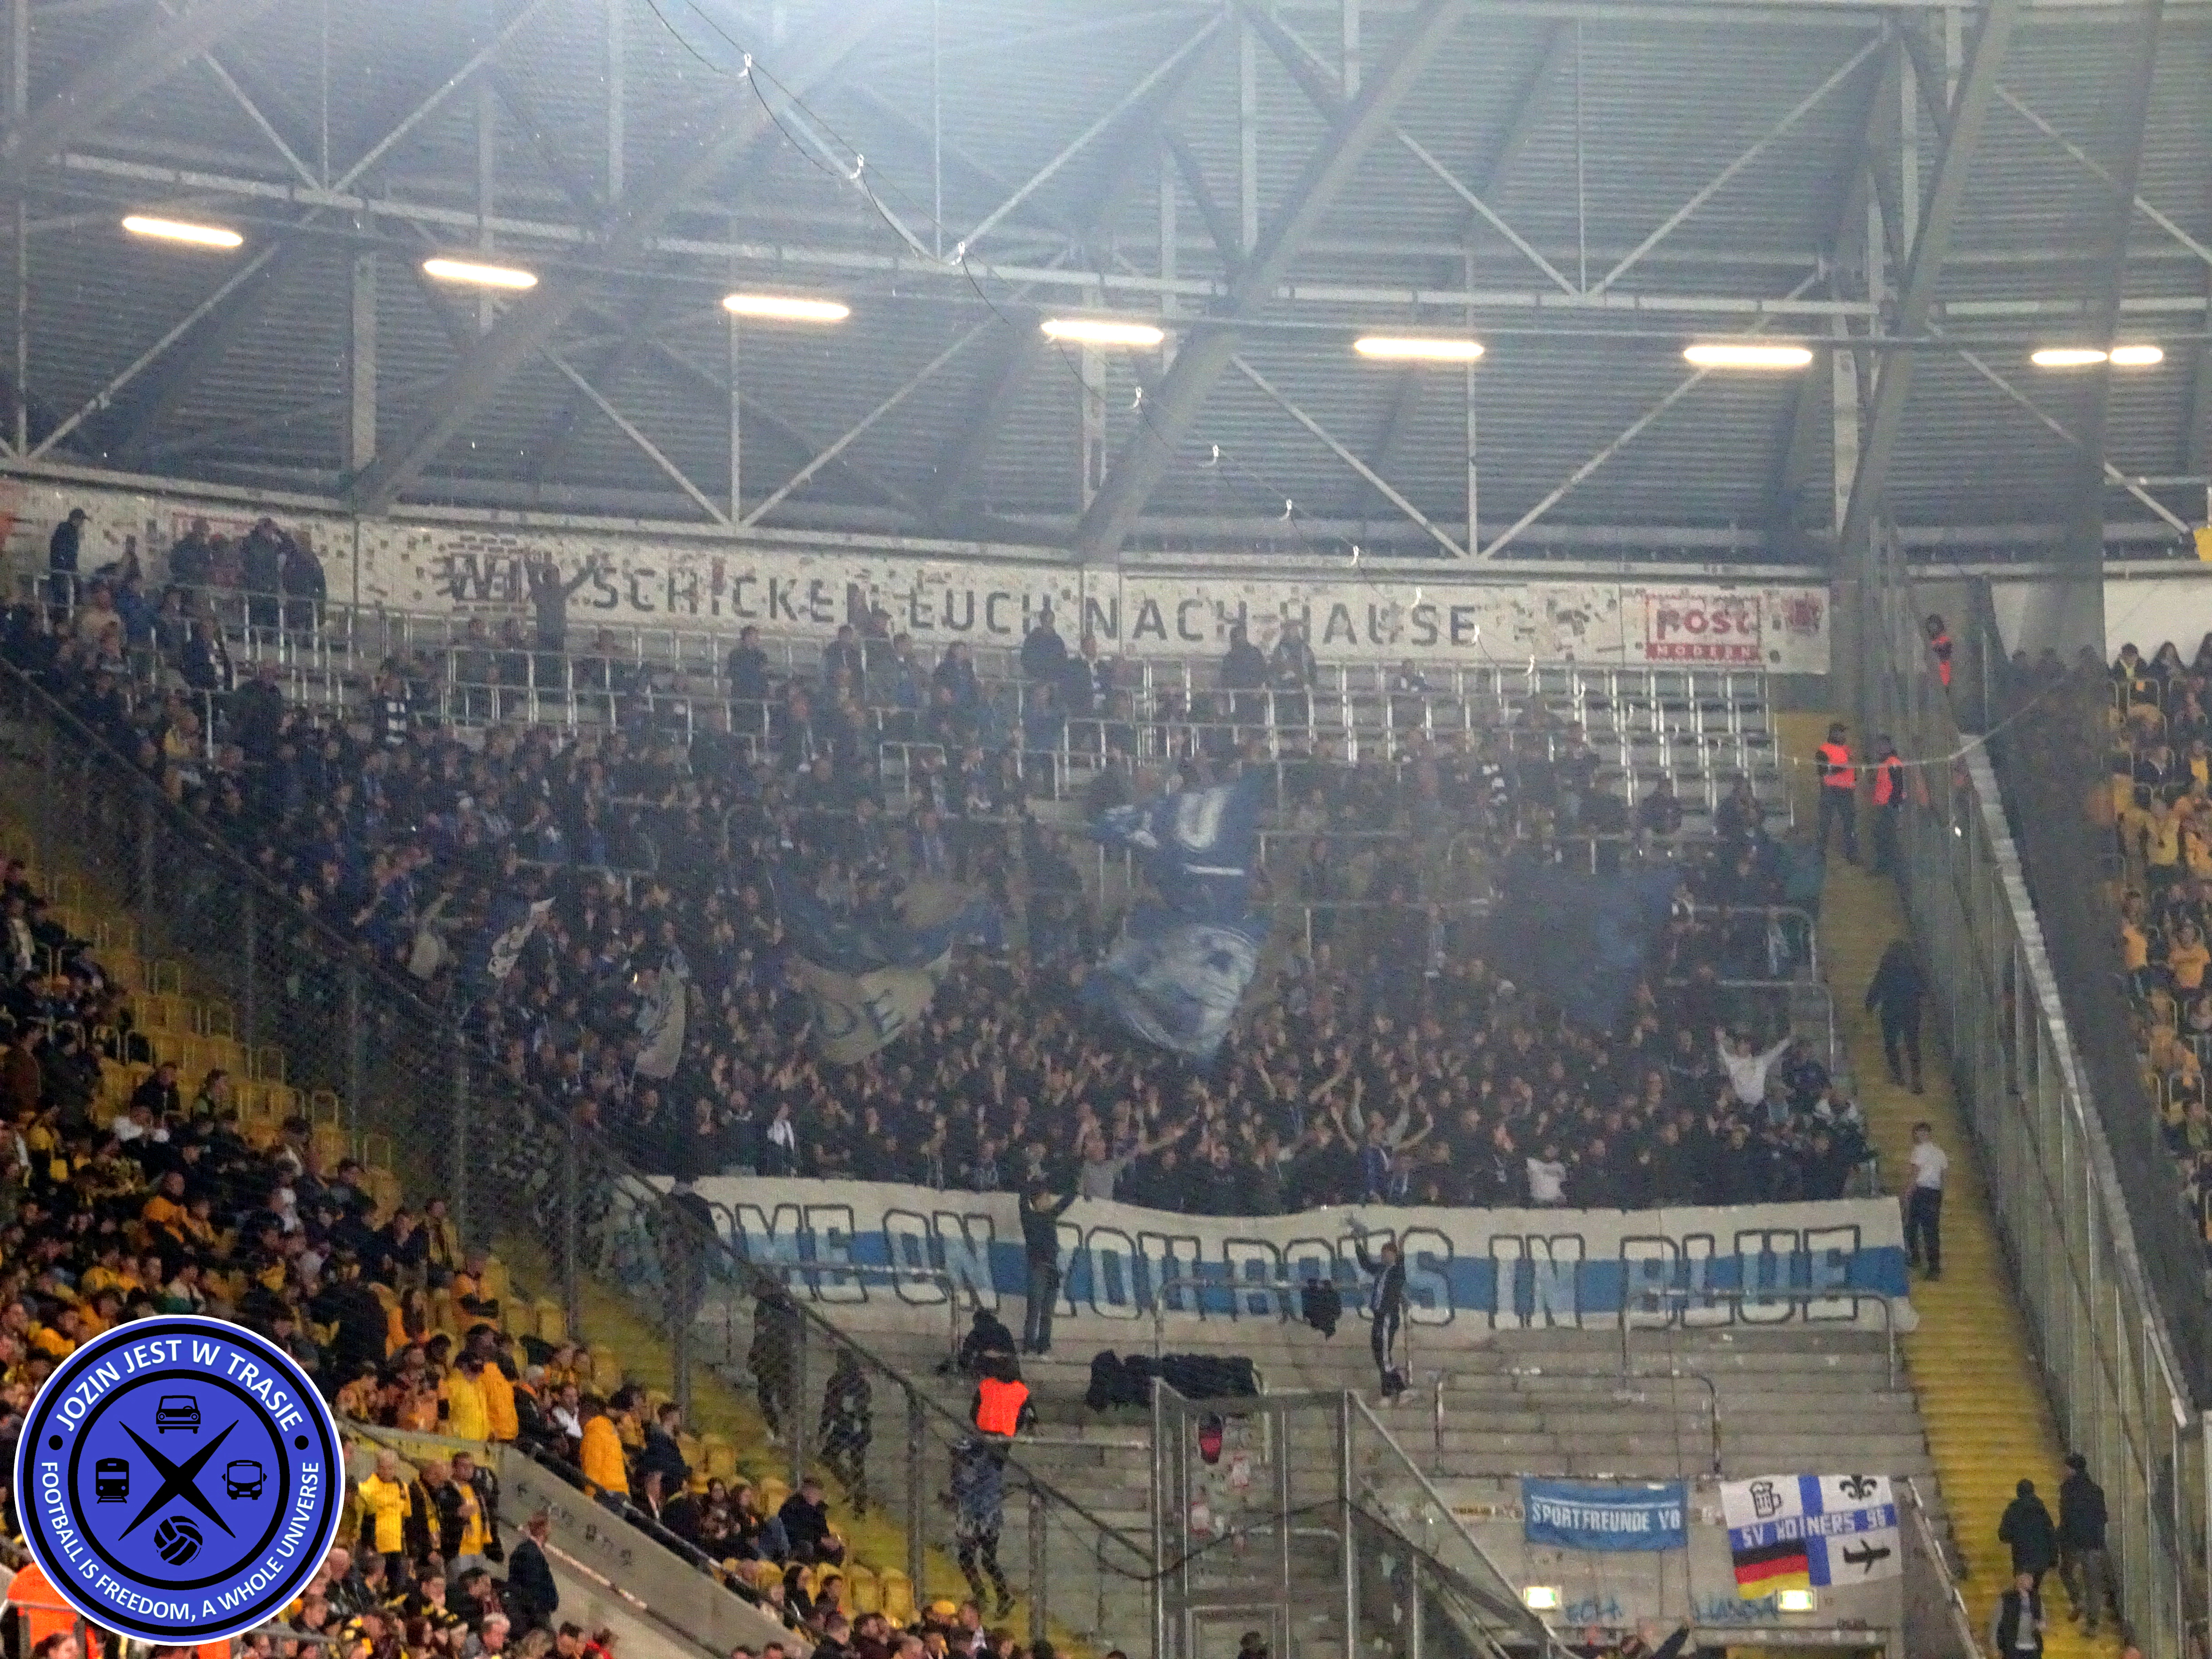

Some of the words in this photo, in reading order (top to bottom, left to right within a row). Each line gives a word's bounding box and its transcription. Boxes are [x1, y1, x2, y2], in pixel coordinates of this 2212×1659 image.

[591, 566, 880, 625] SCHICKEN
[1085, 595, 1248, 642] NACH
[1279, 600, 1476, 647] HAUSE
[1655, 645, 1751, 658] MODERN
[882, 1208, 999, 1312] ON
[1223, 1224, 1456, 1326] BOYS
[1489, 1233, 1585, 1329] IN
[1619, 1223, 1861, 1331] BLUE
[1531, 1501, 1651, 1532] SPORTFREUNDE
[1741, 1524, 1765, 1548] SV
